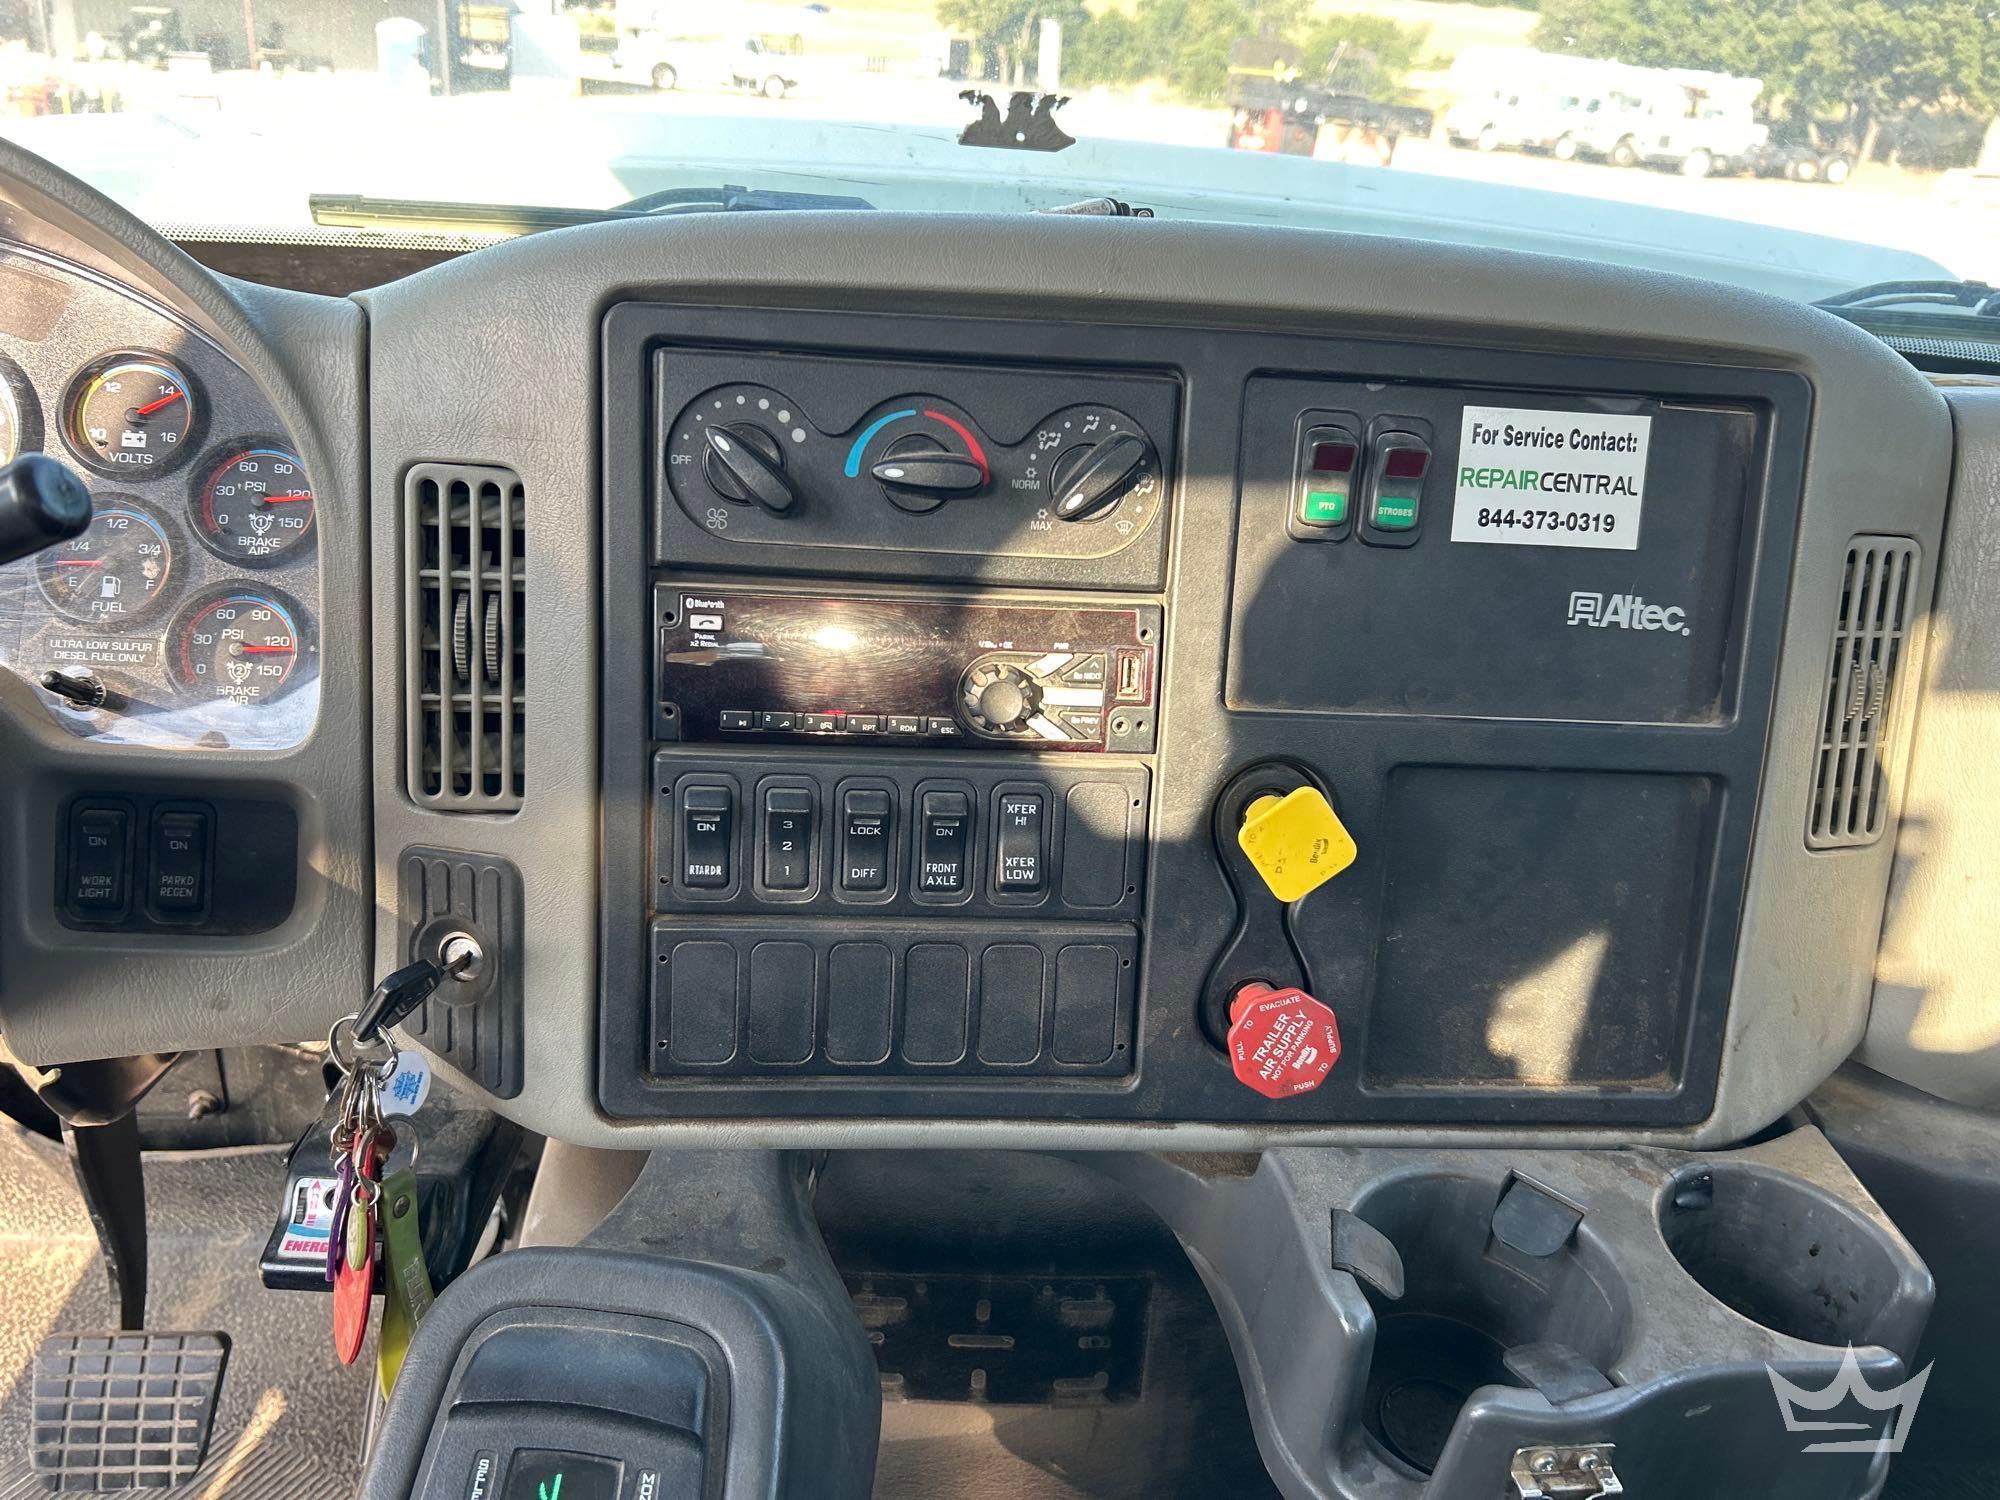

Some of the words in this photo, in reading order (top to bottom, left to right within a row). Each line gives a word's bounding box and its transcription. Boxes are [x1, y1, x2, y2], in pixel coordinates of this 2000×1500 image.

[104, 382, 121, 393] 12
[158, 385, 174, 395] 14
[89, 428, 106, 439] 10
[160, 432, 177, 443] 16
[1472, 423, 1499, 445] For
[1503, 424, 1564, 448] Service
[1569, 428, 1638, 453] Contact:
[109, 452, 153, 464] VOLTS
[671, 455, 692, 464] OFF
[239, 462, 258, 472] 60
[274, 463, 293, 474] 90
[245, 481, 266, 492] PSI
[1012, 479, 1040, 490] NORM
[1460, 467, 1638, 496] REPAIRCENTRAL
[216, 486, 235, 496] 30
[286, 489, 311, 498] 120
[1319, 501, 1335, 510] PTO
[1378, 507, 1413, 517] STROBES
[107, 518, 128, 529] 1/2
[219, 515, 228, 524] 0
[278, 518, 304, 528] 150
[1477, 508, 1615, 533] 844-373-0319
[1030, 520, 1053, 531] MAX
[238, 537, 281, 548] BRAKE
[138, 543, 161, 556] 3/4
[248, 546, 270, 556] AIR
[68, 577, 78, 587] E
[145, 580, 155, 590] F
[92, 601, 127, 613] FUEL
[216, 609, 235, 620] 60
[252, 610, 271, 621] 90
[193, 634, 212, 645] 30
[222, 629, 244, 640] PSI
[50, 640, 83, 648] ULTRA
[86, 641, 110, 650] LOW
[111, 642, 152, 651] SULFUR
[263, 635, 290, 647] 120
[54, 651, 88, 660] DIESEL
[91, 652, 116, 661] FUEL
[118, 653, 146, 662] ONLY
[196, 664, 206, 674] 0
[256, 665, 282, 676] 150
[216, 685, 260, 696] BRAKE
[228, 695, 249, 705] AIR
[1007, 804, 1037, 815] XFER
[783, 821, 793, 829] 3
[1015, 817, 1027, 826] HI
[697, 823, 715, 832] ON
[851, 827, 881, 835] LOCK
[936, 828, 953, 837] ON
[88, 836, 107, 846] ON
[169, 840, 188, 850] ON
[782, 841, 793, 851] 2
[1005, 857, 1035, 867] XFER
[689, 865, 722, 875] RTARDR
[785, 866, 790, 875] 1
[852, 869, 877, 878] DIFF
[926, 863, 958, 873] FRONT
[81, 876, 112, 885] WORK
[161, 875, 194, 885] PARKD
[1007, 870, 1034, 880] LOW
[926, 876, 957, 886] AXLE
[78, 888, 112, 898] LIGHT
[159, 887, 192, 897] REGEN
[1259, 995, 1301, 1012] EVACUATE
[1243, 1020, 1254, 1030] TO
[1252, 1013, 1290, 1062] TRAILER
[1325, 1025, 1337, 1054] SUPPLY
[1259, 1058, 1278, 1080] AIR
[1273, 1009, 1307, 1058] SUPPLY
[1236, 1041, 1245, 1061] PULL
[1271, 1065, 1285, 1081] NOT
[1282, 1050, 1294, 1067] FOR
[1292, 1020, 1314, 1052] PARKING
[1318, 1062, 1329, 1073] TO
[1293, 1080, 1315, 1091] PUSH
[284, 1240, 328, 1252] ENERG
[471, 1459, 490, 1500] SELE
